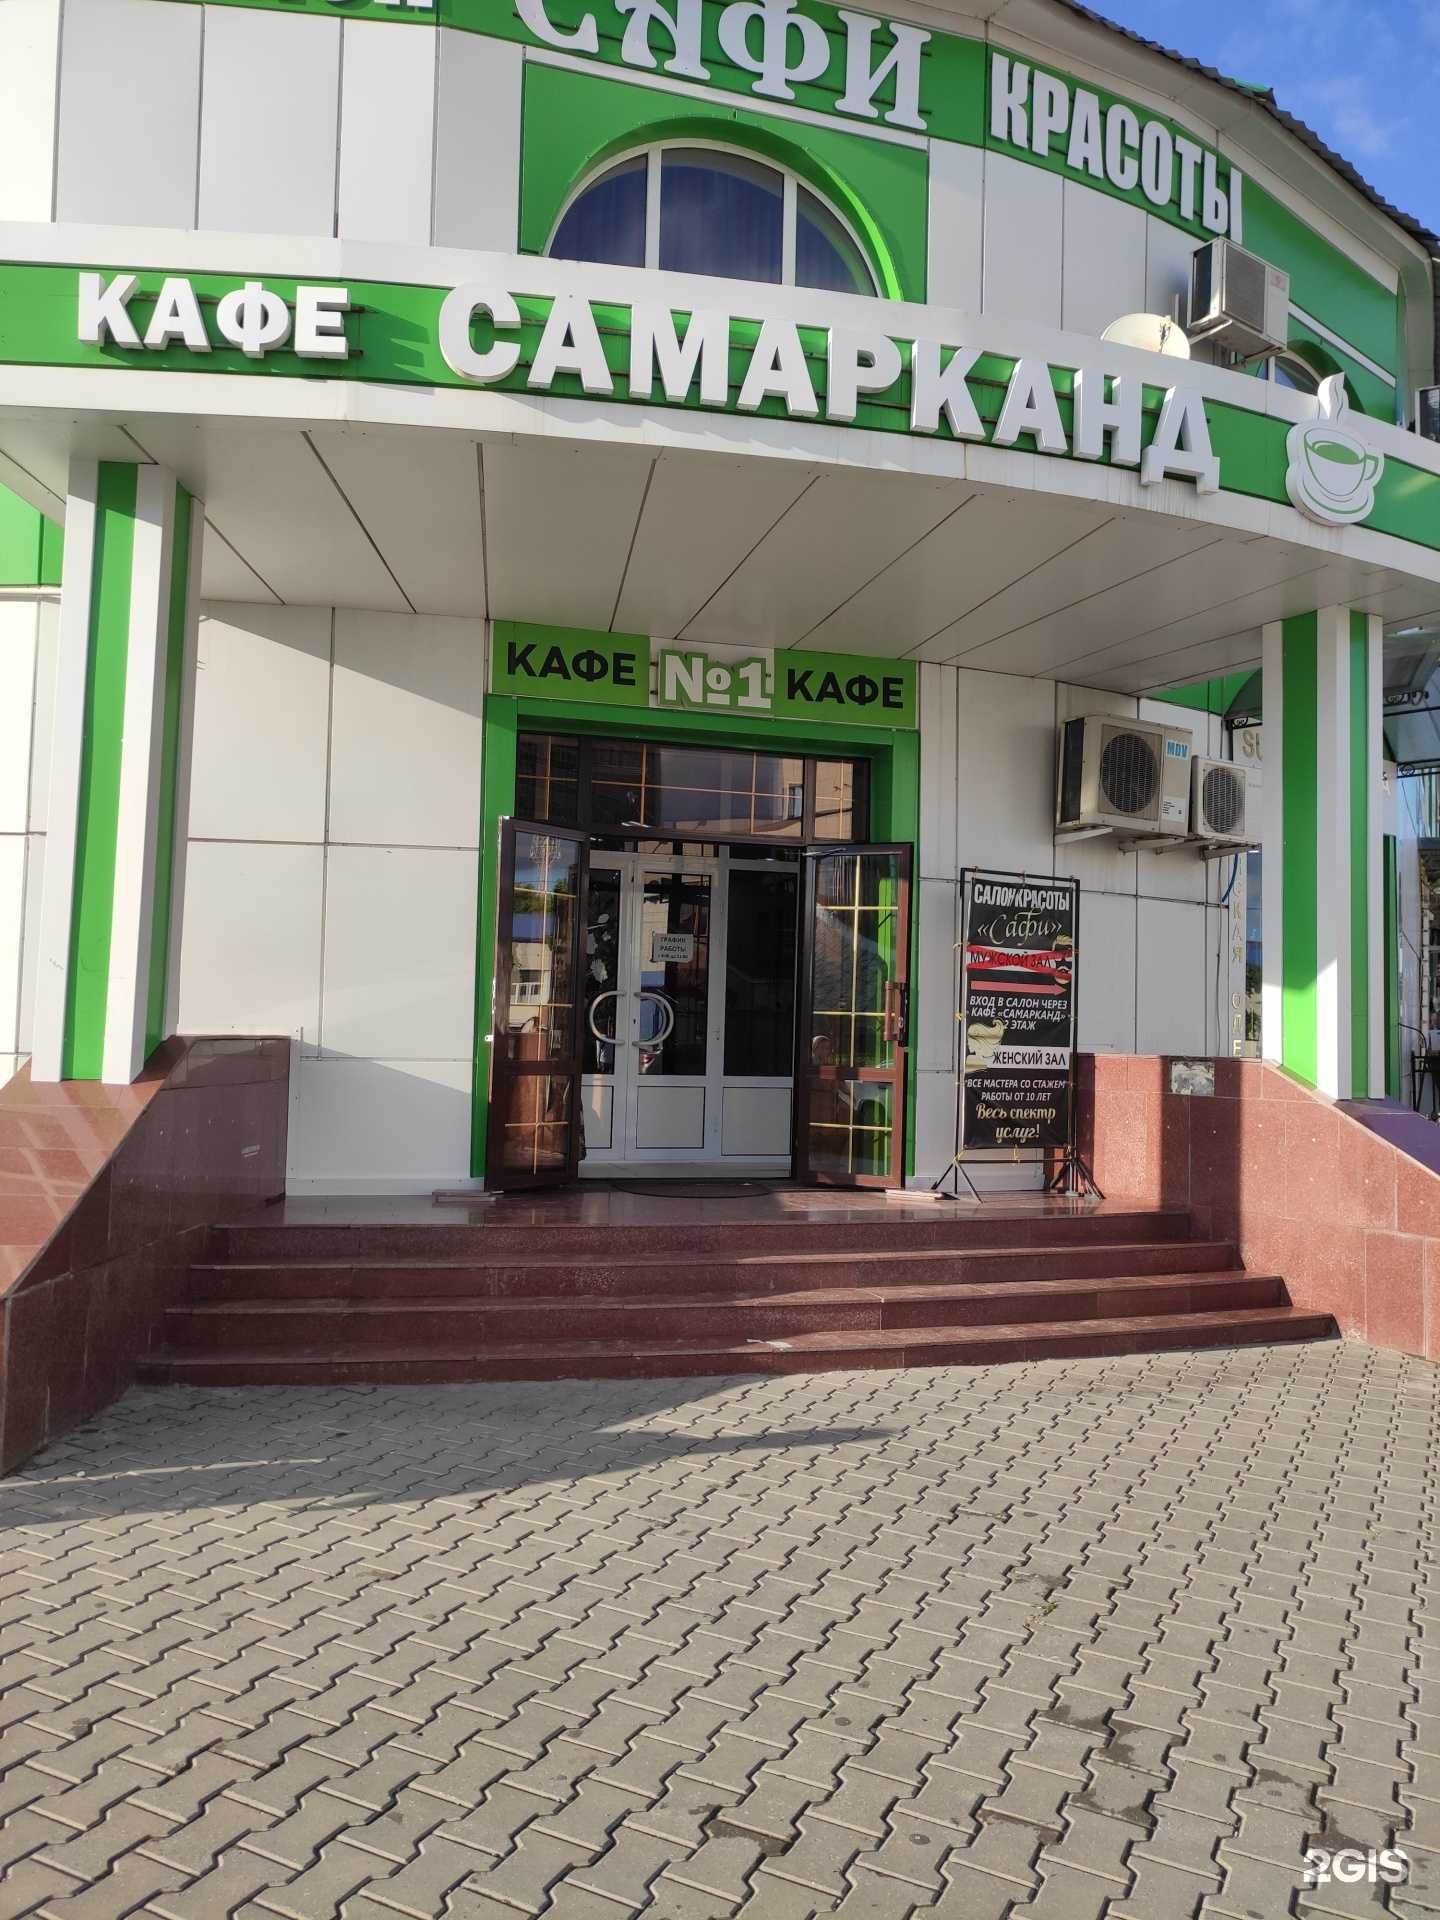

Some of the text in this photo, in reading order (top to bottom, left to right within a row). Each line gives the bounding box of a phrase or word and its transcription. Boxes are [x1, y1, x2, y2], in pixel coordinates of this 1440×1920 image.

[991, 53, 1243, 243] КРАСОТЫ
[78, 272, 1220, 495] КАФЕ САМАРКАНД
[507, 641, 636, 686] КАФЕ
[787, 668, 904, 708] КАФЕ
[1167, 741, 1188, 758] MDV
[1014, 888, 1070, 911] КРАСОТЫ
[970, 996, 1068, 1010] ВХОД В САЛОН ЧЕРЕЗ
[971, 1007, 1066, 1022] КАФЕ «САМАРКАНД»
[1003, 1019, 1037, 1030] 2 ЭТАЖ
[993, 1050, 1066, 1065] ЖЕНСКИЙ ЗАЛ
[967, 1079, 1065, 1089] ВСЕ МАСТЕРА СО СТАЖЕМ
[981, 1092, 1052, 1101] РАБОТЫ ОТ 10 ЛЕТ
[976, 1103, 1056, 1124] Весь спектр
[995, 1123, 1040, 1144] услуг!
